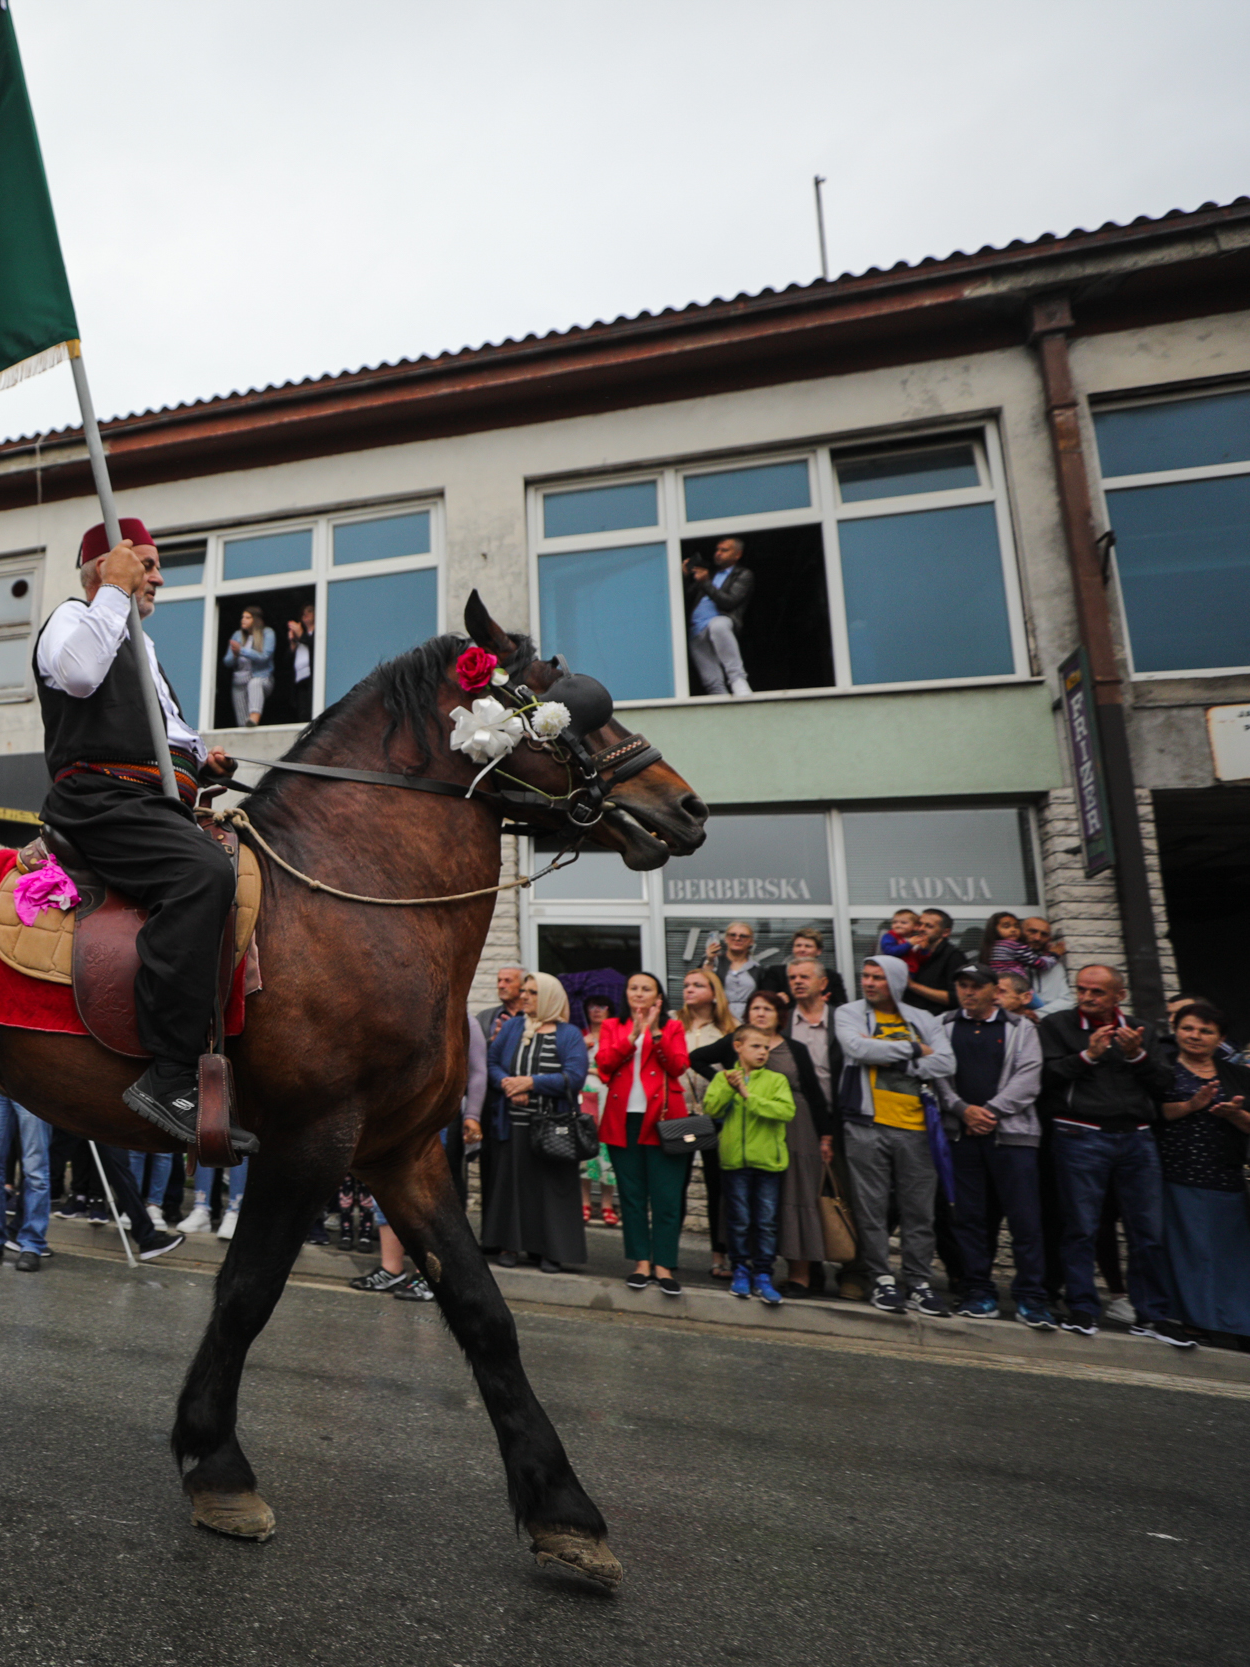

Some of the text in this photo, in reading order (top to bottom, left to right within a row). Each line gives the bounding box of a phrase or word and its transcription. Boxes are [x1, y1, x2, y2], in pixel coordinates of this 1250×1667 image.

[1070, 691, 1102, 835] FRIZER
[668, 875, 993, 902] BERBERSKA RADNJA
